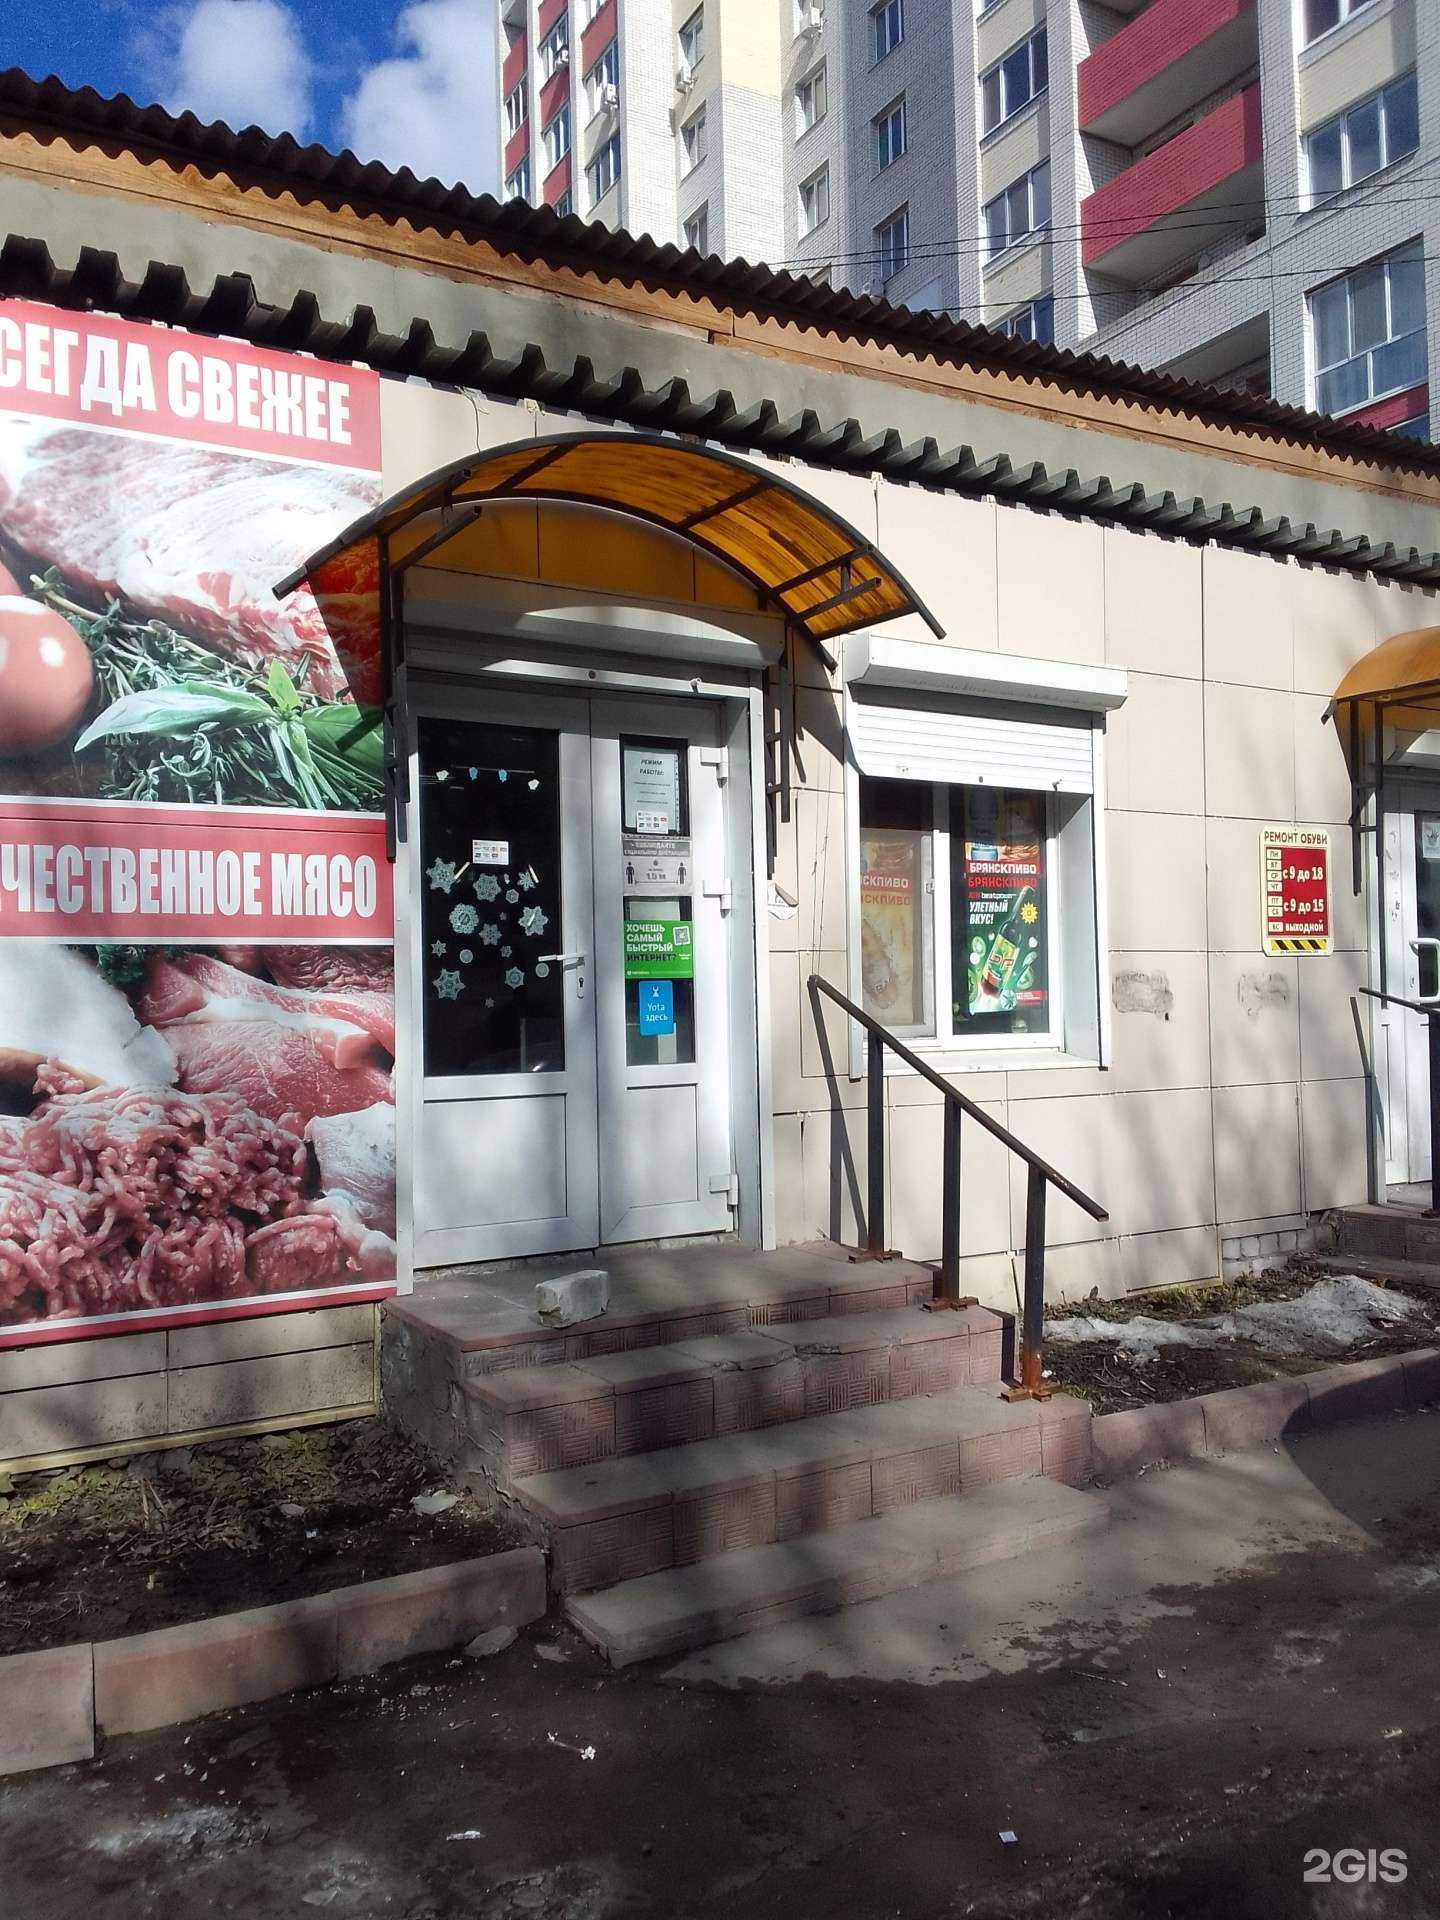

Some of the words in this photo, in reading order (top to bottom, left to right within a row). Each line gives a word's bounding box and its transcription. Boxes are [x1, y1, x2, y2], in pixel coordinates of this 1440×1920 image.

[167, 350, 352, 446] СВЕЖЕЕ
[1264, 831, 1298, 843] РЕМОНТ
[1300, 833, 1328, 845] ОБУВИ
[969, 862, 1037, 874] БРЯНСКПИВО
[1282, 870, 1288, 879] с
[1290, 866, 1295, 879] 9
[1297, 869, 1310, 883] до
[1312, 866, 1324, 880] 18
[1, 844, 262, 916] ЧЕСТВЕННОЕ
[271, 853, 377, 918] МЯСО
[970, 899, 1008, 913] УЛЕТНЫЙ
[1283, 902, 1289, 911] с
[1291, 898, 1296, 912] 9
[1298, 902, 1311, 915] до
[1312, 898, 1324, 912] 15
[969, 913, 995, 925] ВКУС!
[626, 924, 665, 933] ХОЧЕШЬ
[1285, 920, 1324, 934] выходной
[626, 933, 663, 942] САМЫЙ
[626, 943, 673, 952] БЫСТРЫЙ
[627, 953, 677, 962] ИНТЕРНЕТ?
[647, 1003, 665, 1011] Yota
[645, 1014, 668, 1022] здесь
